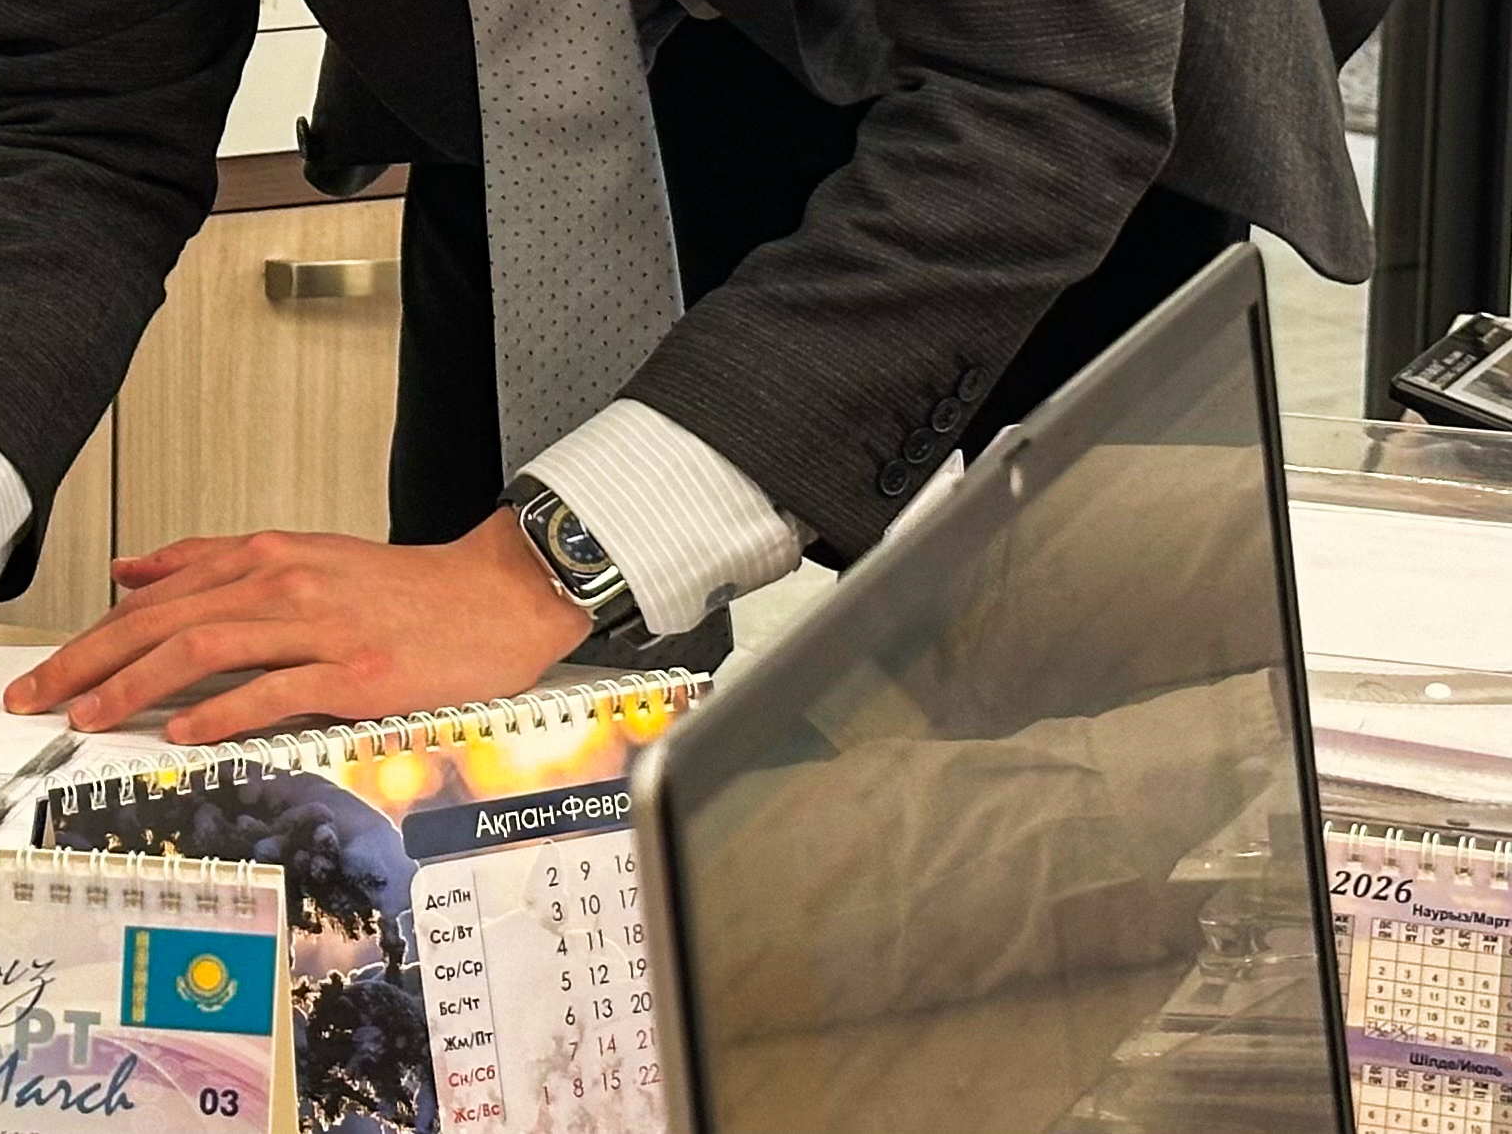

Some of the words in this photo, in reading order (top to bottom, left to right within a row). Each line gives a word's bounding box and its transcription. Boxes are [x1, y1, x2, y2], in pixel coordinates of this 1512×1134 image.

[425, 888, 472, 911] Дс/Пн
[546, 866, 559, 887] 2
[580, 860, 591, 881] 9
[614, 853, 636, 874] 16
[1330, 870, 1413, 904] 2026
[429, 925, 473, 945] Сс/Вт
[551, 901, 563, 922] 3
[580, 894, 601, 916] 10
[619, 887, 638, 909] 17
[434, 959, 483, 982] Ср/Ср
[556, 936, 568, 956] 4
[586, 929, 604, 951] 11
[624, 923, 645, 946] 18
[439, 996, 480, 1016] Бс/Чт
[561, 971, 571, 992] 5
[589, 964, 610, 986] 12
[628, 958, 647, 979] 19
[1378, 966, 1385, 976] 2
[1431, 974, 1438, 983] 4
[1458, 977, 1464, 987] 5
[565, 1006, 576, 1026] 6
[593, 998, 614, 1020] 13
[630, 991, 653, 1014] 20
[1429, 992, 1439, 1001] 11
[1454, 995, 1466, 1006] 12
[1478, 998, 1490, 1008] 13
[1399, 1007, 1410, 1017] 17
[1453, 1014, 1465, 1025] 19
[1477, 1018, 1489, 1028] 20
[448, 1064, 496, 1088] Сн/Сб
[569, 1041, 579, 1061] 7
[598, 1034, 617, 1057] 14
[637, 1027, 656, 1050] 21
[1476, 1039, 1488, 1048] 27
[543, 1085, 551, 1106] 1
[573, 1078, 584, 1098] 8
[602, 1069, 621, 1092] 15
[639, 1063, 661, 1086] 22
[199, 1087, 240, 1117] 03
[1449, 1103, 1456, 1112] 2
